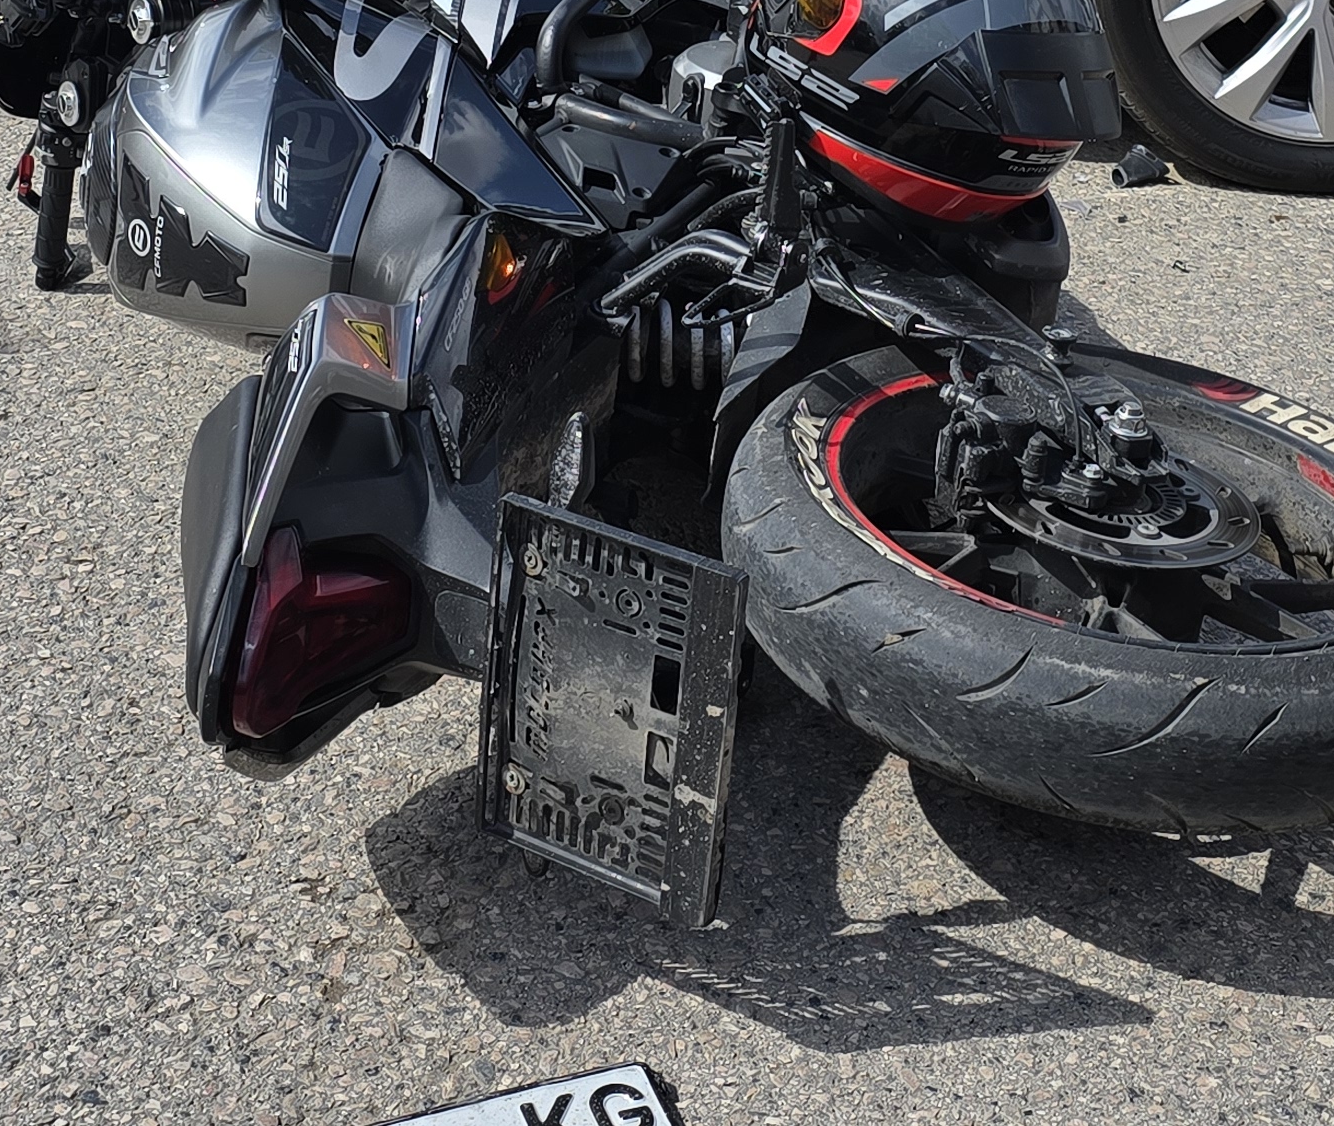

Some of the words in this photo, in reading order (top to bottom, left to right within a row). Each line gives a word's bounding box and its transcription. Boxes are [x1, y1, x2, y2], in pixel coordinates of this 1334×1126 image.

[749, 31, 860, 111] LS2
[997, 148, 1074, 165] LS2
[154, 215, 165, 278] CFMOTO
